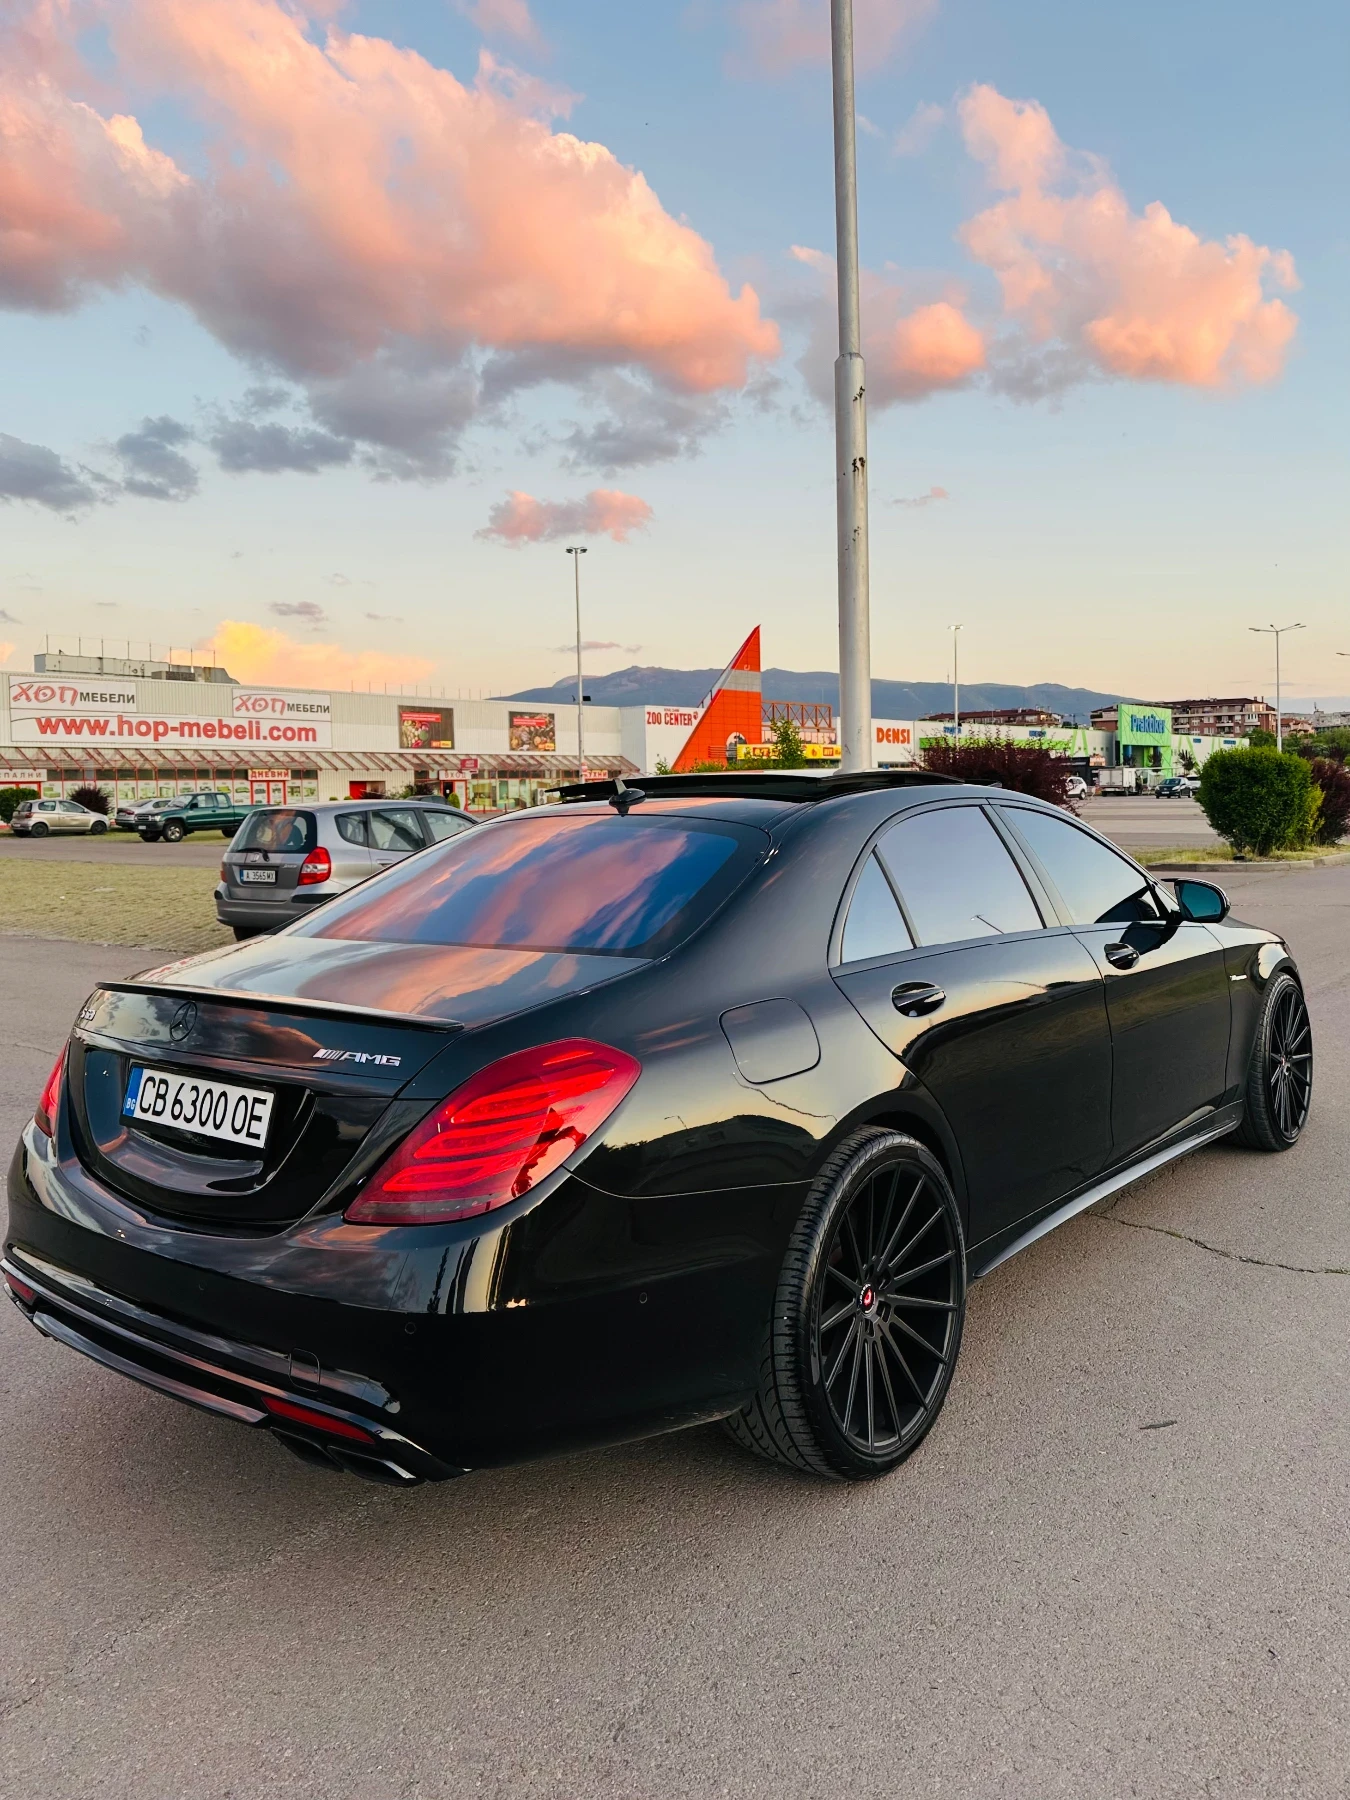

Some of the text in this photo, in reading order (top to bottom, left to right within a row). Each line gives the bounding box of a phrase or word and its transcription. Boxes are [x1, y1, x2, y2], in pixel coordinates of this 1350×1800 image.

[79, 692, 135, 704] МЕБЕЛИ
[287, 703, 330, 714] МЕБЕЛИ
[646, 711, 693, 726] ZOO CENTER
[35, 715, 317, 742] www.hop-mebeli.com
[876, 727, 911, 745] DENSI
[250, 770, 289, 779] ДНЕВНИ
[340, 1051, 401, 1066] AMG
[126, 1098, 136, 1109] BG
